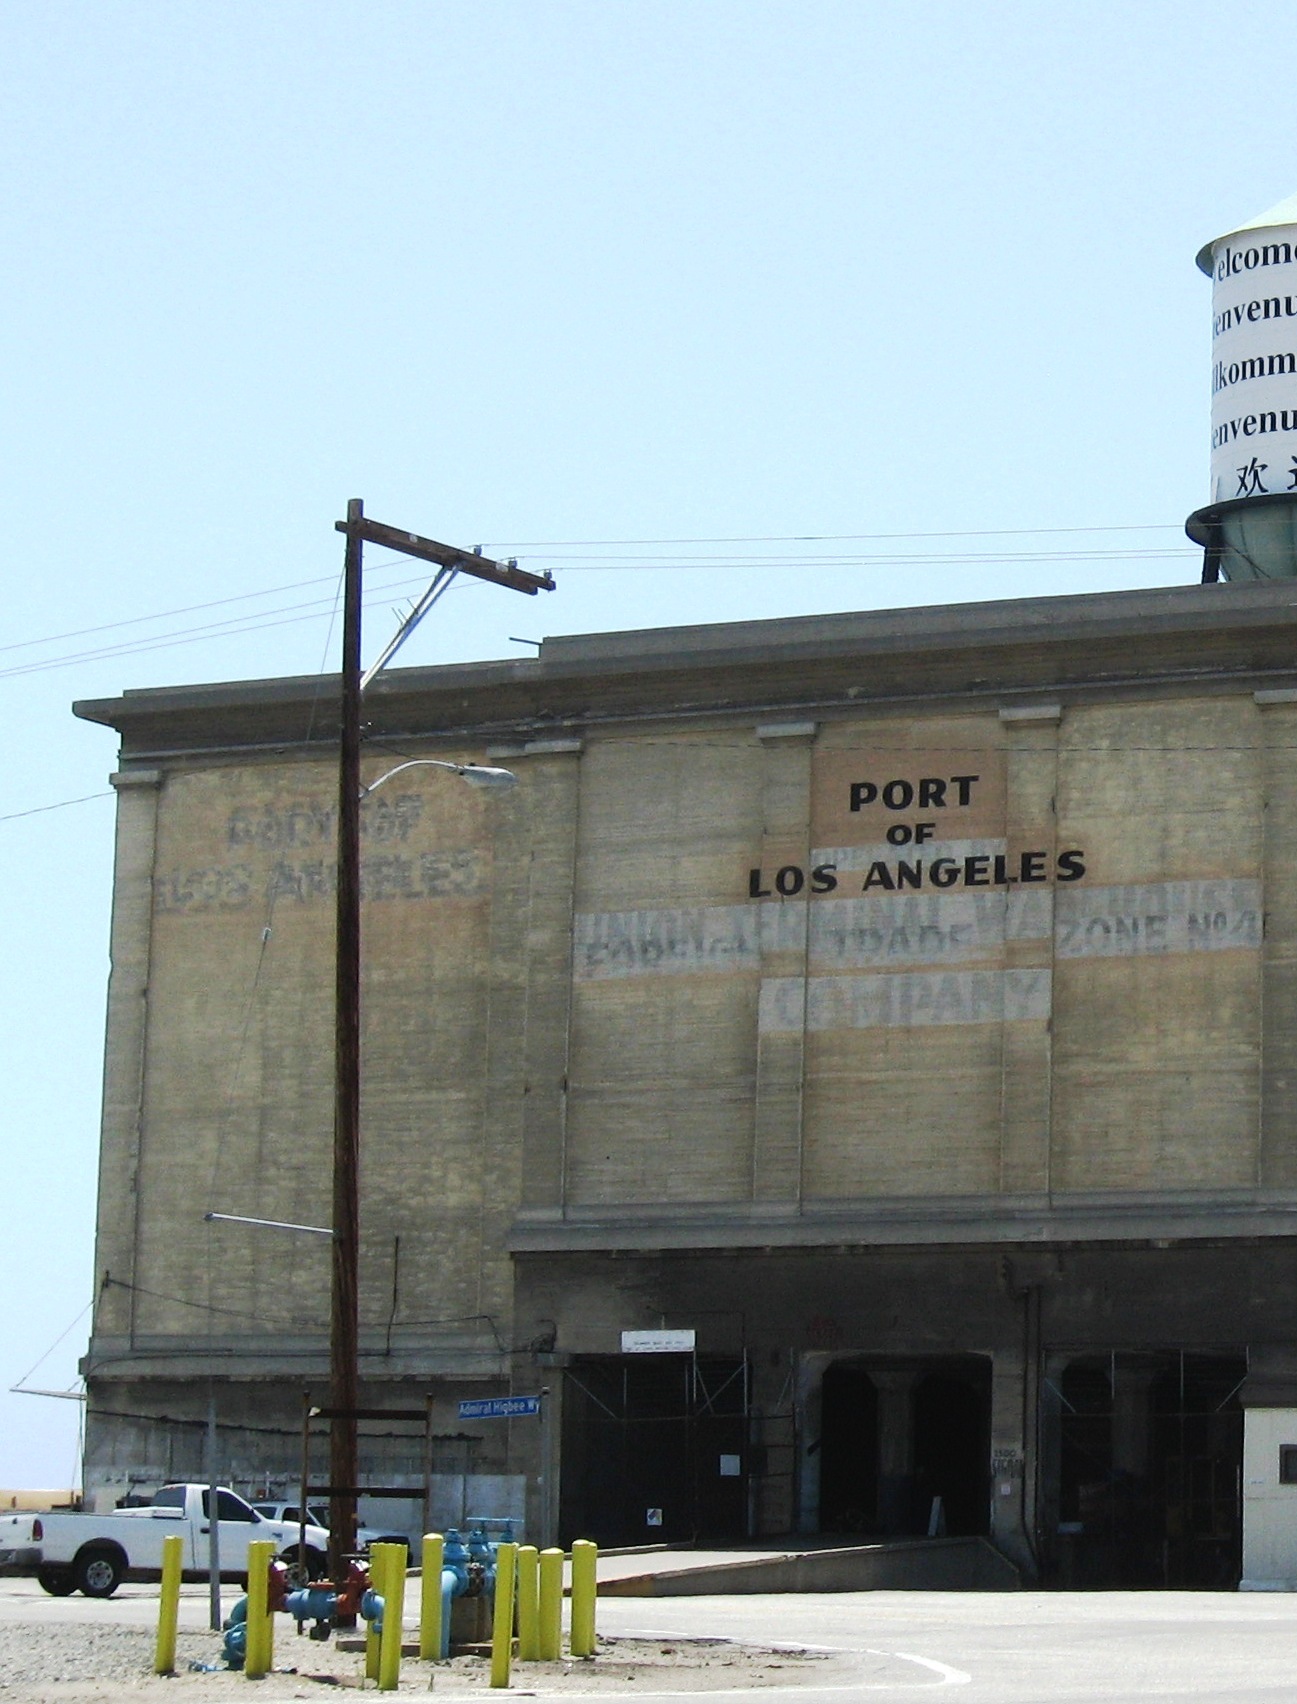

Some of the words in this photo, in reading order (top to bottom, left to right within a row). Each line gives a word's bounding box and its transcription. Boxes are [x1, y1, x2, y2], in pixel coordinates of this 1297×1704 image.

[849, 775, 979, 812] PORT
[886, 822, 936, 846] OF
[749, 864, 837, 899] LOS
[862, 850, 1087, 892] ANGELES
[460, 1401, 491, 1415] Admiral
[493, 1401, 525, 1415] Higbee
